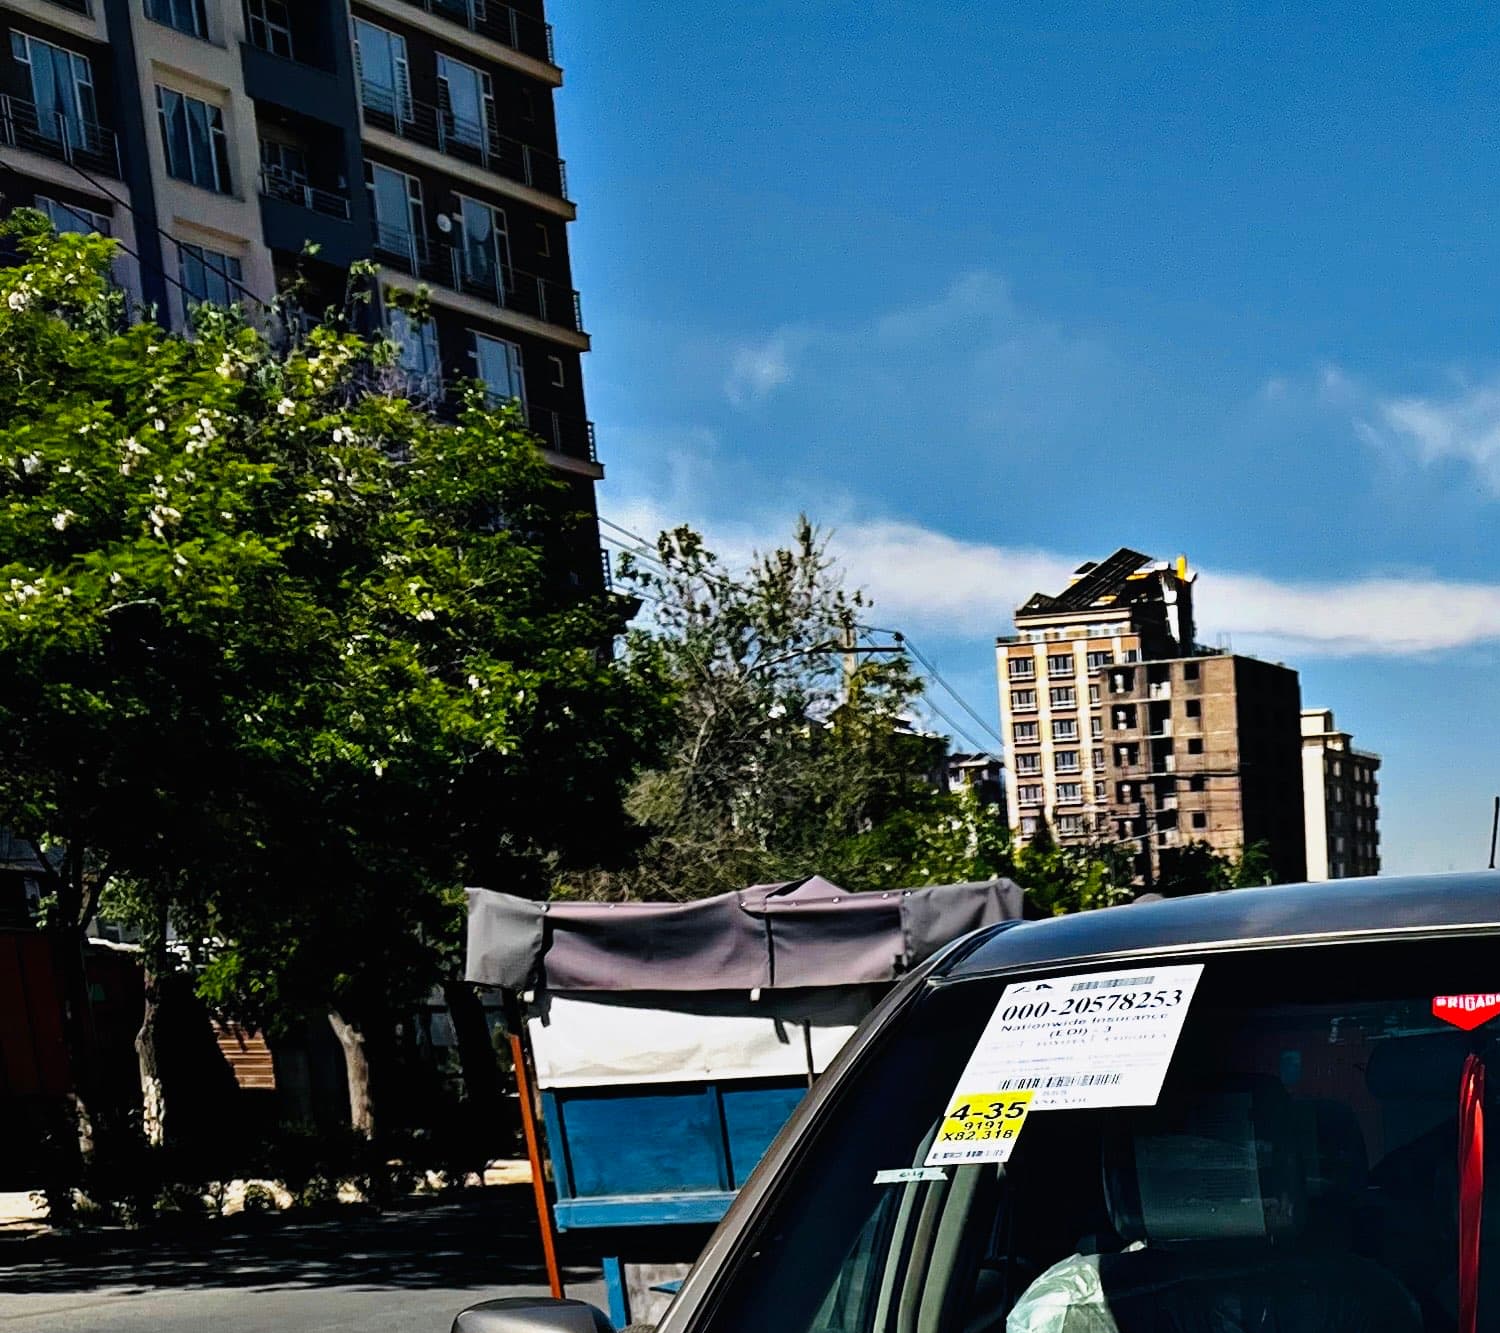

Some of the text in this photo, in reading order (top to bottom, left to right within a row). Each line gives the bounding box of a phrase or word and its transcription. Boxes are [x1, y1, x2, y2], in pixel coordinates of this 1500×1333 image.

[1001, 989, 1183, 1022] 000-20578253
[949, 1101, 1027, 1121] 4-35
[964, 1120, 1004, 1131] 9191
